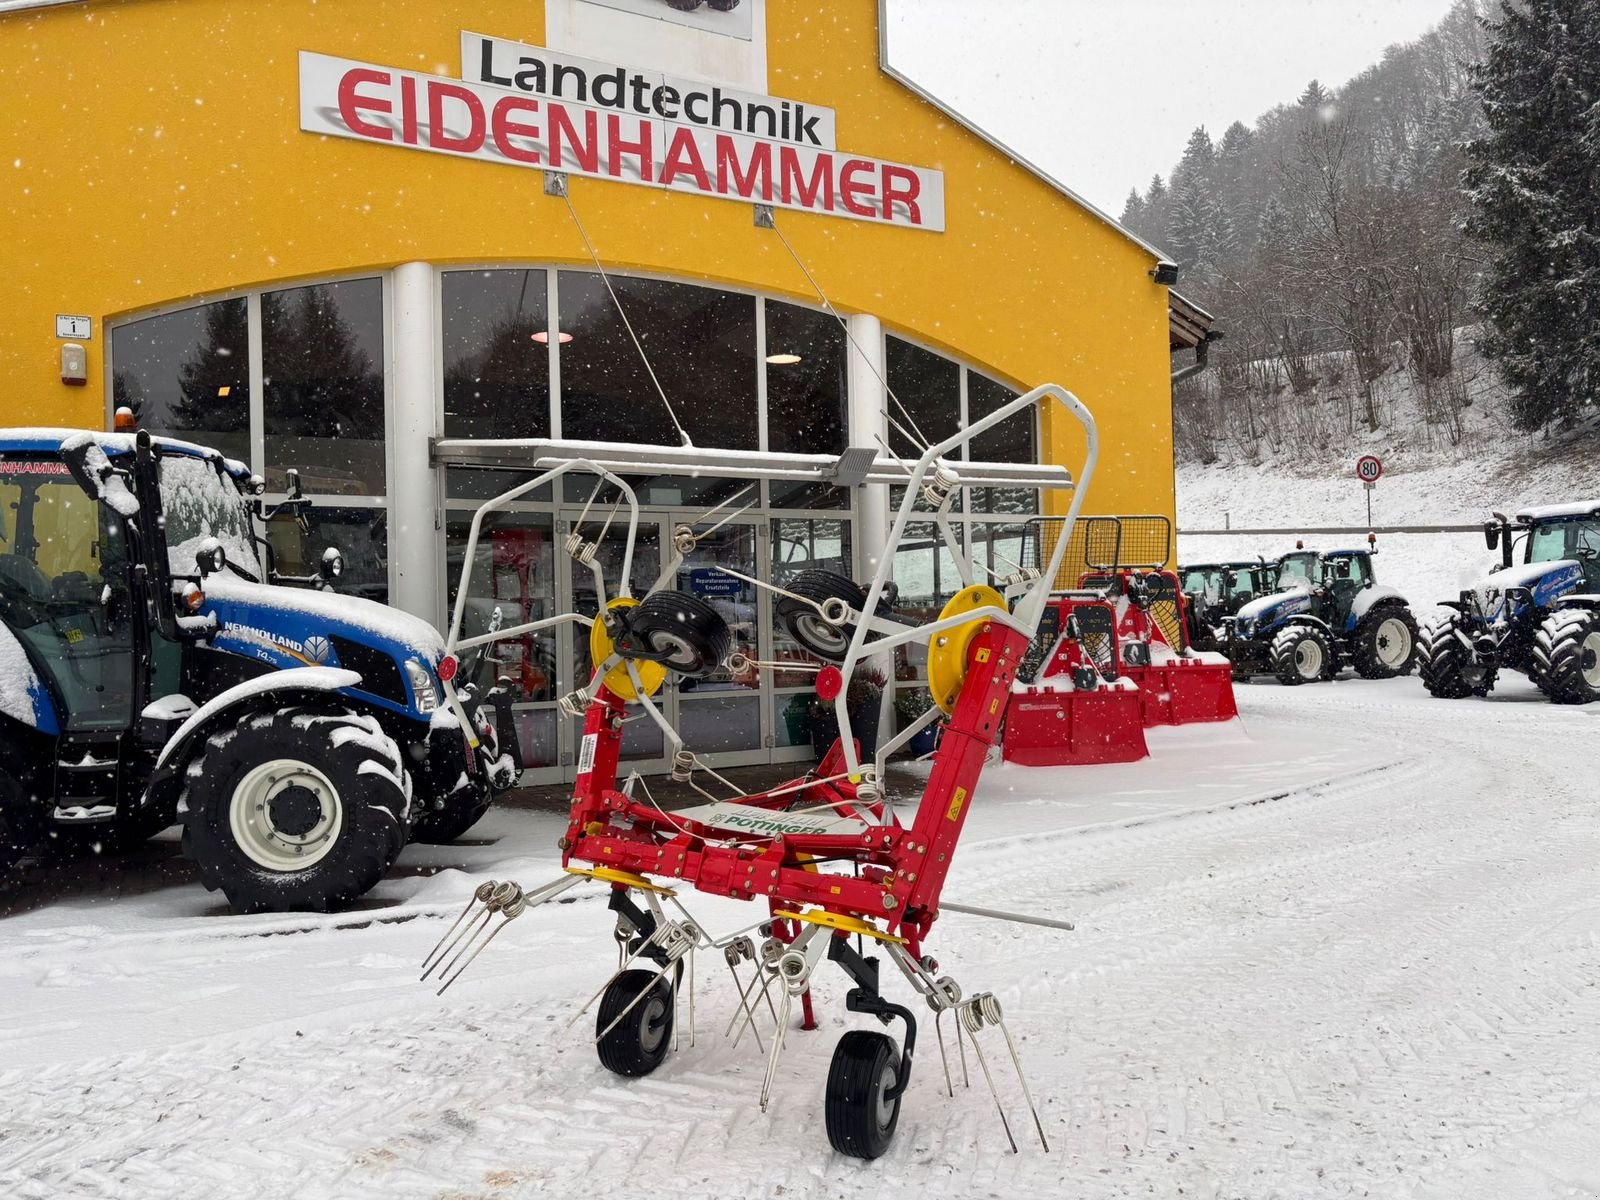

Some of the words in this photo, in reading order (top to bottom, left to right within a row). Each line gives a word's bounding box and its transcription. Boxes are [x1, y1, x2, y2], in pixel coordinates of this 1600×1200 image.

[481, 38, 822, 146] Landtechnik
[338, 68, 922, 225] EIDENHAMMER
[1362, 461, 1377, 476] 80
